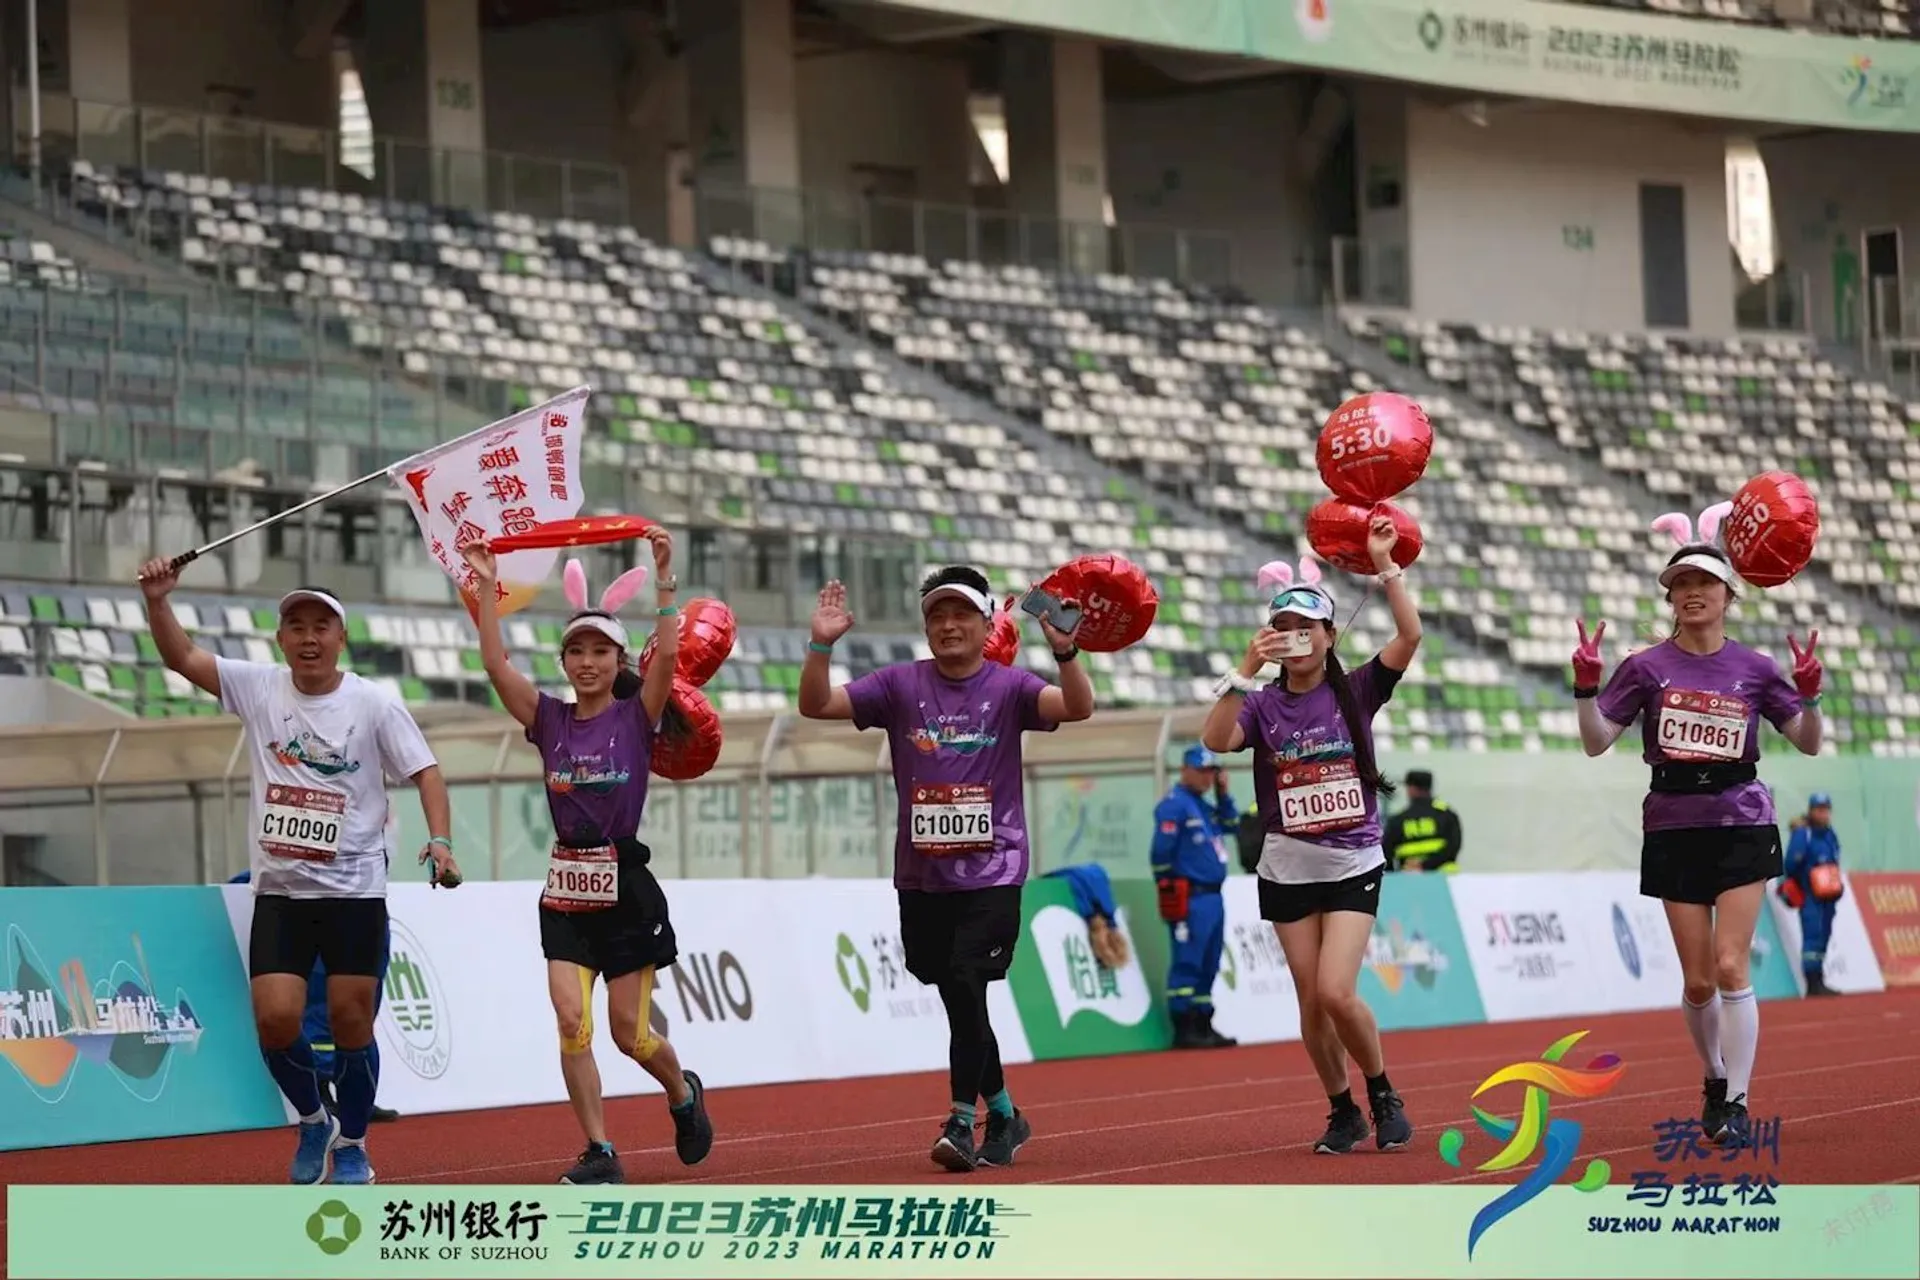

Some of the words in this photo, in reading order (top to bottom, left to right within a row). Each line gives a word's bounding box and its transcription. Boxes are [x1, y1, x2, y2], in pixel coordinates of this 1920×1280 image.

[1331, 423, 1392, 460] 5:30
[1730, 502, 1770, 558] 5:30
[1662, 718, 1741, 750] C10861
[1285, 789, 1361, 819] C10860
[263, 813, 338, 844] C10090
[914, 813, 990, 836] C10076
[547, 867, 615, 894] C10862
[670, 950, 753, 1024] NIO
